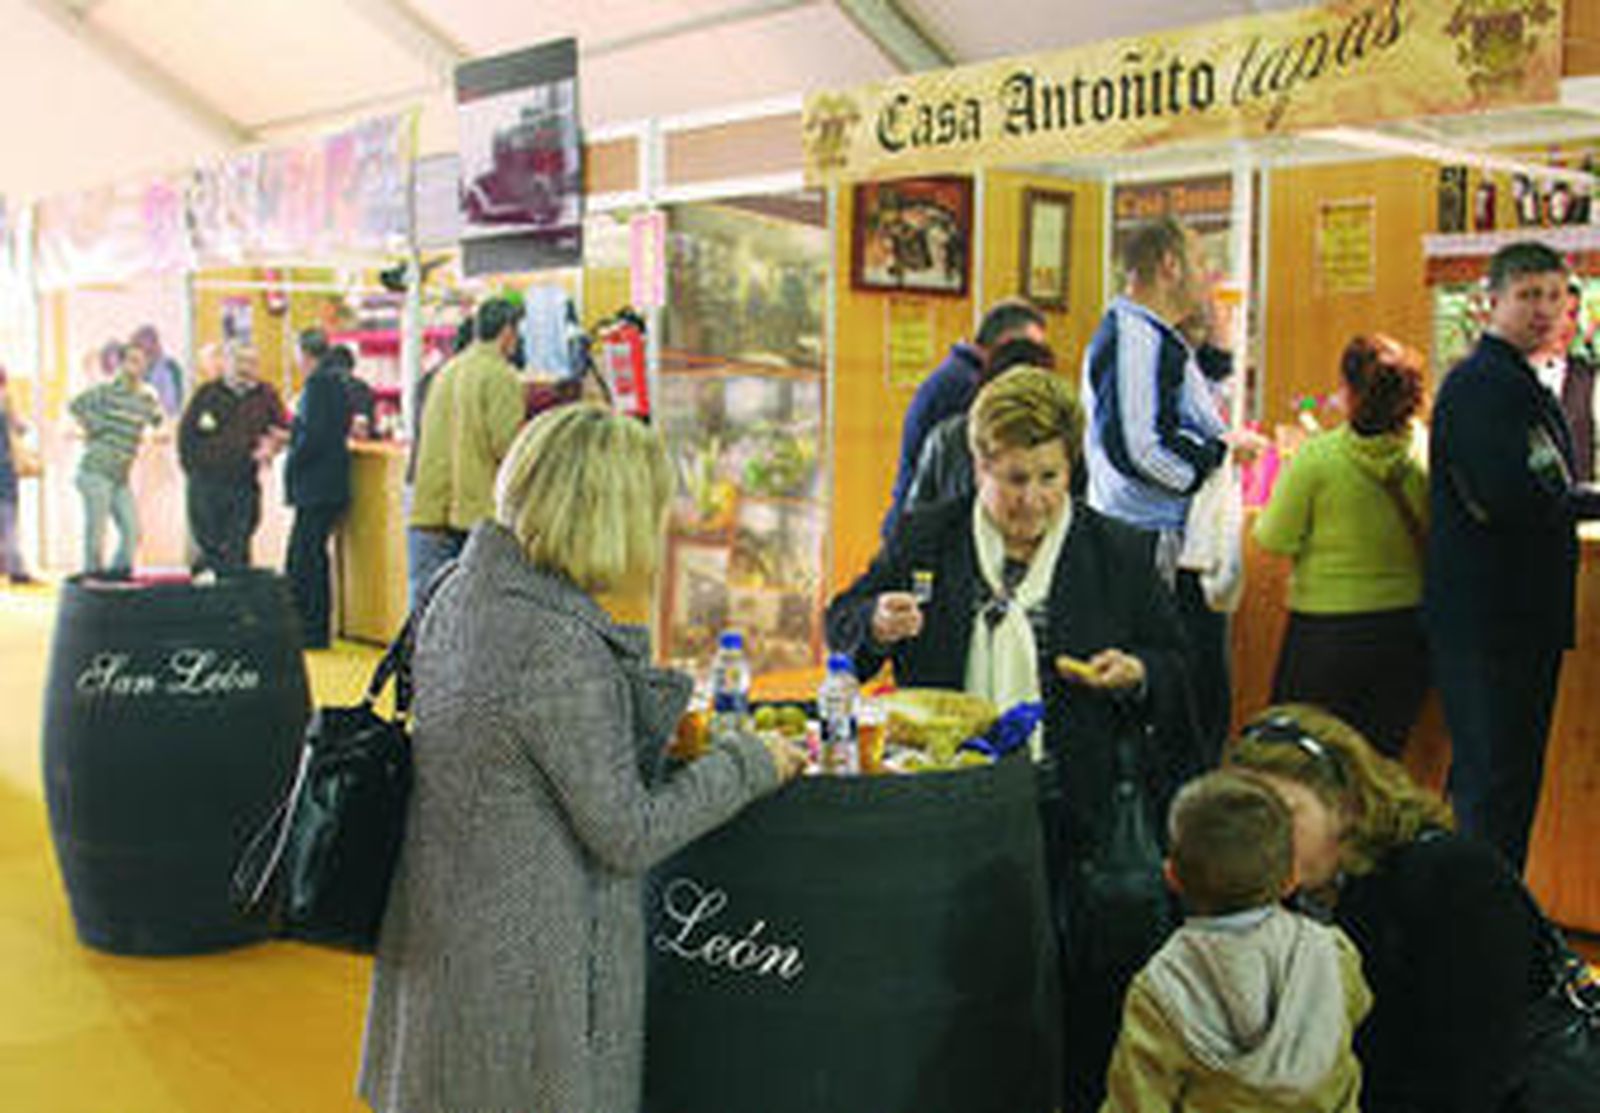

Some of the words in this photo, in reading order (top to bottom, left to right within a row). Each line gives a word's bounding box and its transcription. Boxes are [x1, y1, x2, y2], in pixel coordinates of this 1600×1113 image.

[876, 93, 981, 153] Casa
[1002, 52, 1215, 136] Antoñito
[76, 652, 155, 695] San
[164, 649, 259, 695] León
[653, 877, 804, 980] León
